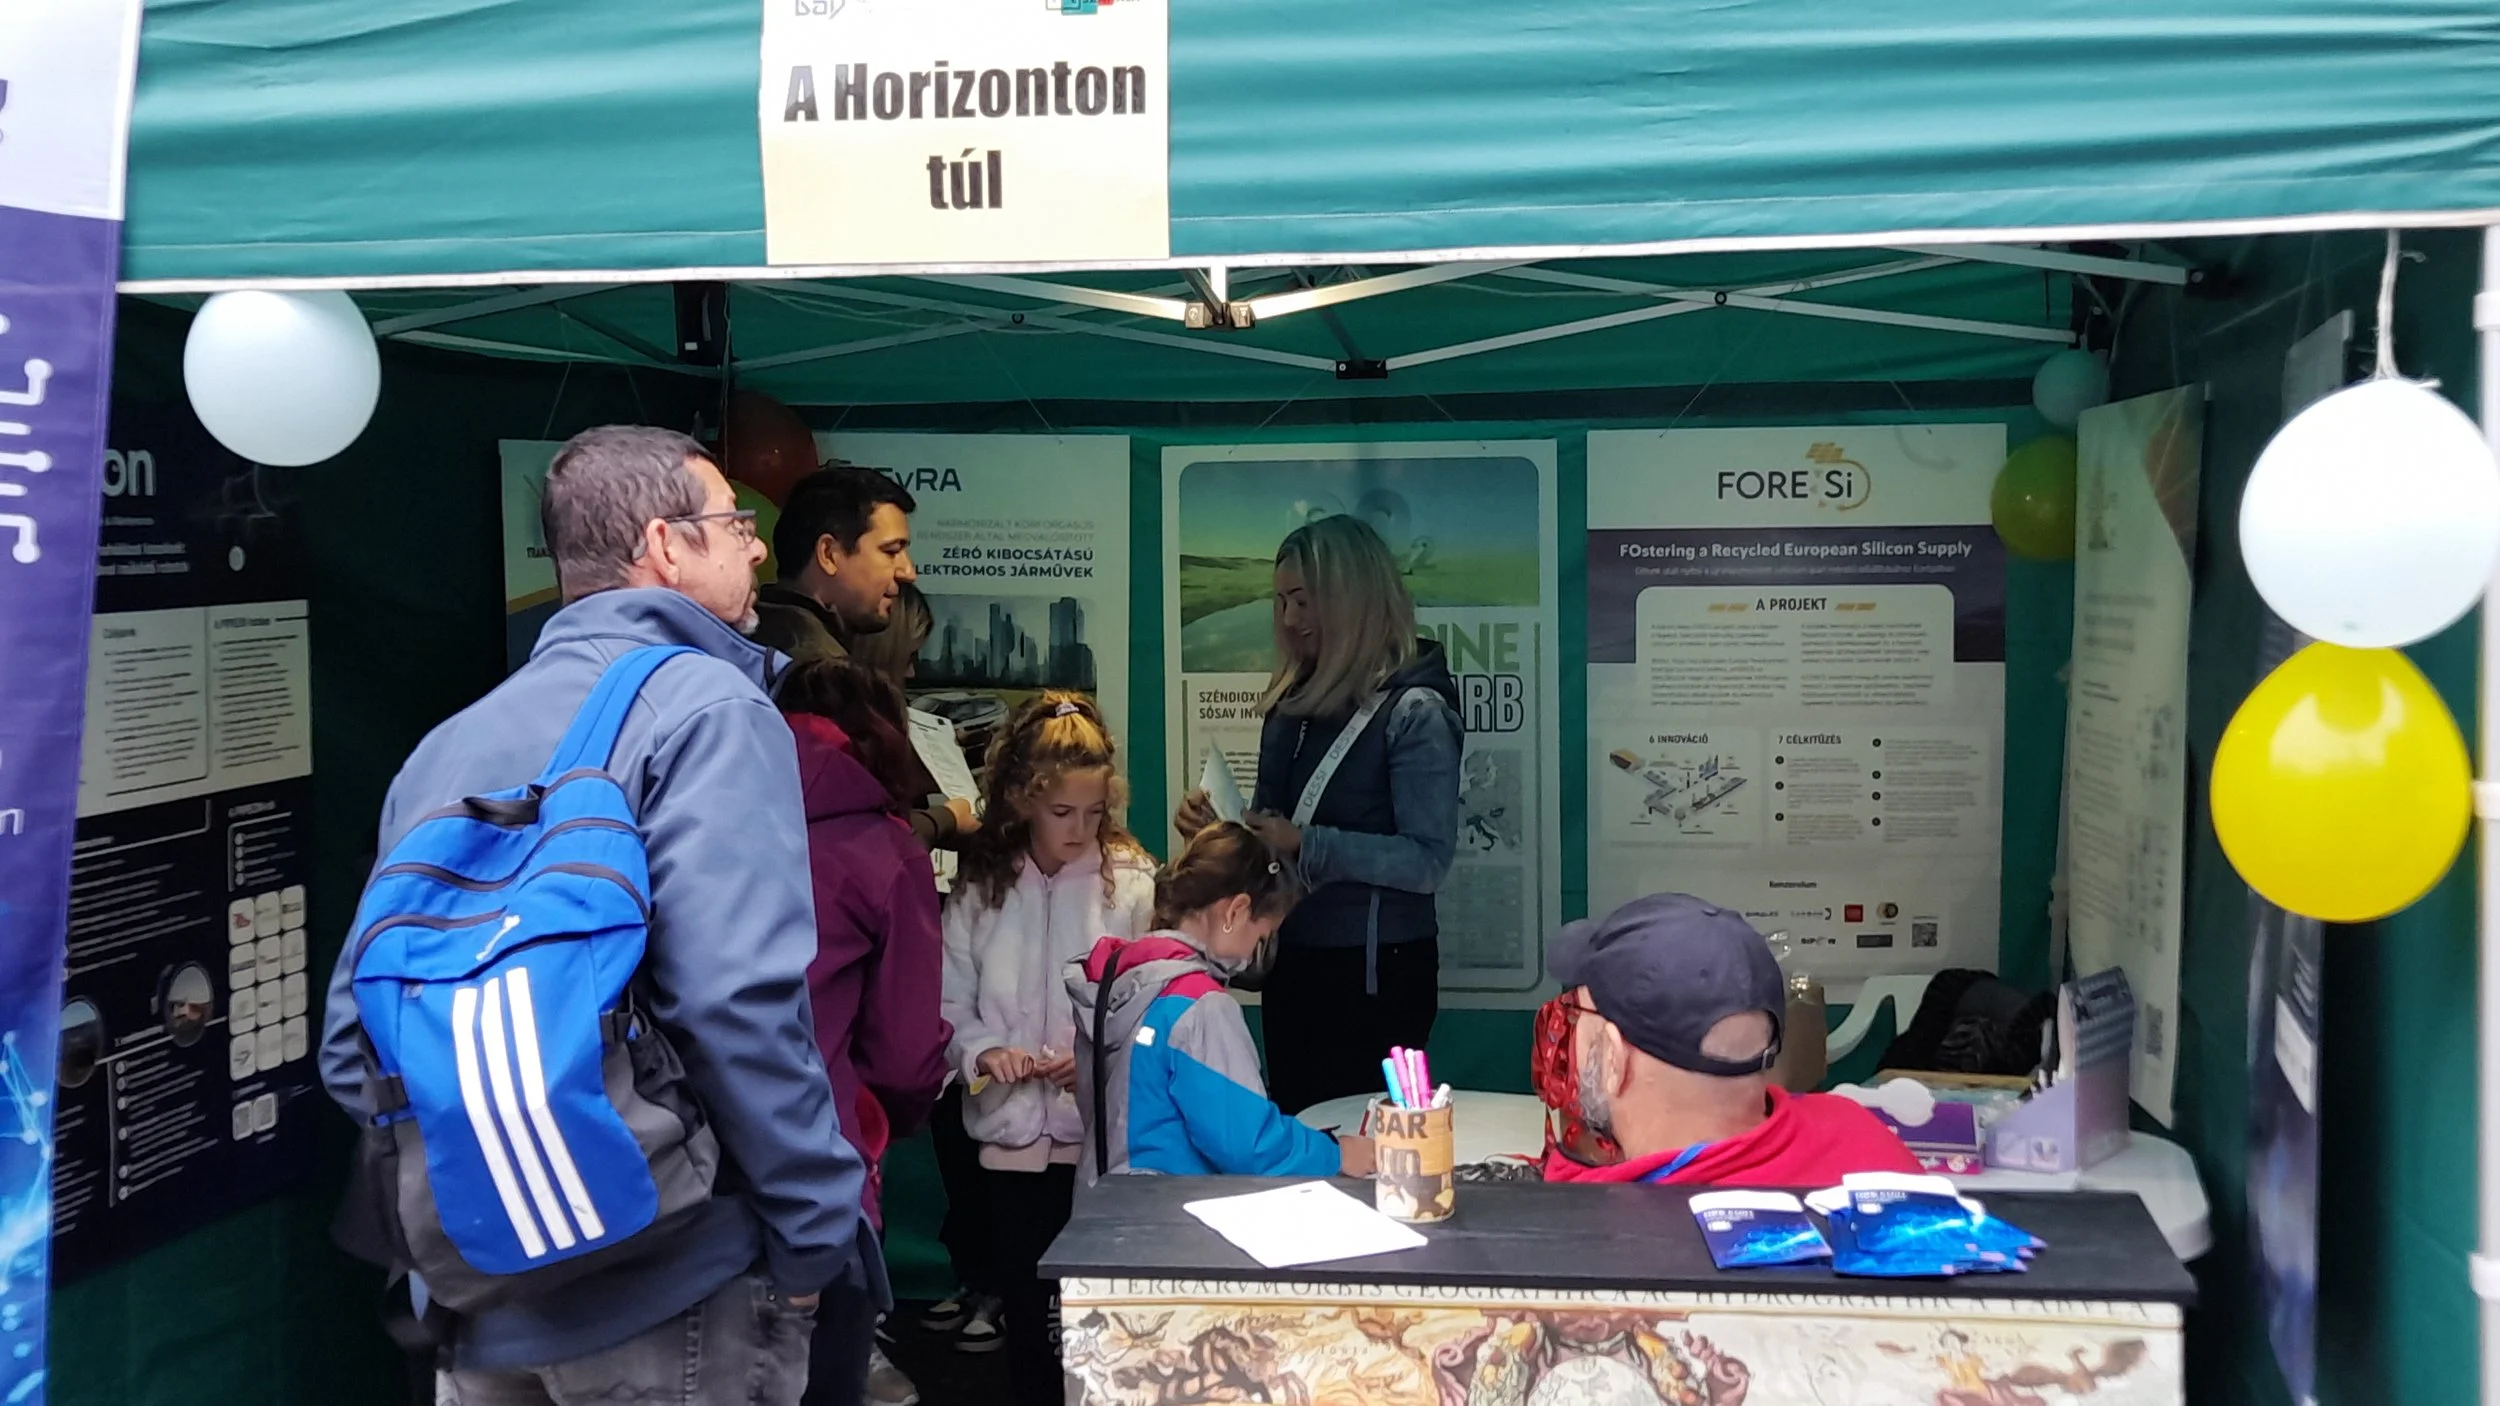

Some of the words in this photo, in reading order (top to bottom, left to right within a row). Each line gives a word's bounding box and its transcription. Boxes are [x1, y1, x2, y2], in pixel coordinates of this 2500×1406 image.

[783, 65, 819, 122] A
[834, 60, 1147, 121] Horizonton
[926, 148, 1003, 210] túl
[873, 467, 962, 492] vRA
[942, 545, 982, 560] ZÉRÓ
[987, 545, 1093, 561] KIBOCSÁTÁSÚ
[1619, 543, 1695, 560] FOstering
[1698, 547, 1707, 558] a
[1711, 542, 1780, 560] Recycled
[1784, 542, 1858, 559] European
[1861, 541, 1913, 556] Silicon
[1917, 539, 1973, 558] Supply
[916, 564, 1006, 577] LEKTROMOS
[1010, 563, 1093, 578] JÁRMŰVEK
[1755, 598, 1766, 612] A
[1769, 597, 1827, 612] PROJEKT
[1416, 622, 1521, 673] INE
[1199, 705, 1236, 719] SÓSAV
[1449, 674, 1524, 733] RB
[1657, 732, 1709, 745] INNOVÁCIÓ
